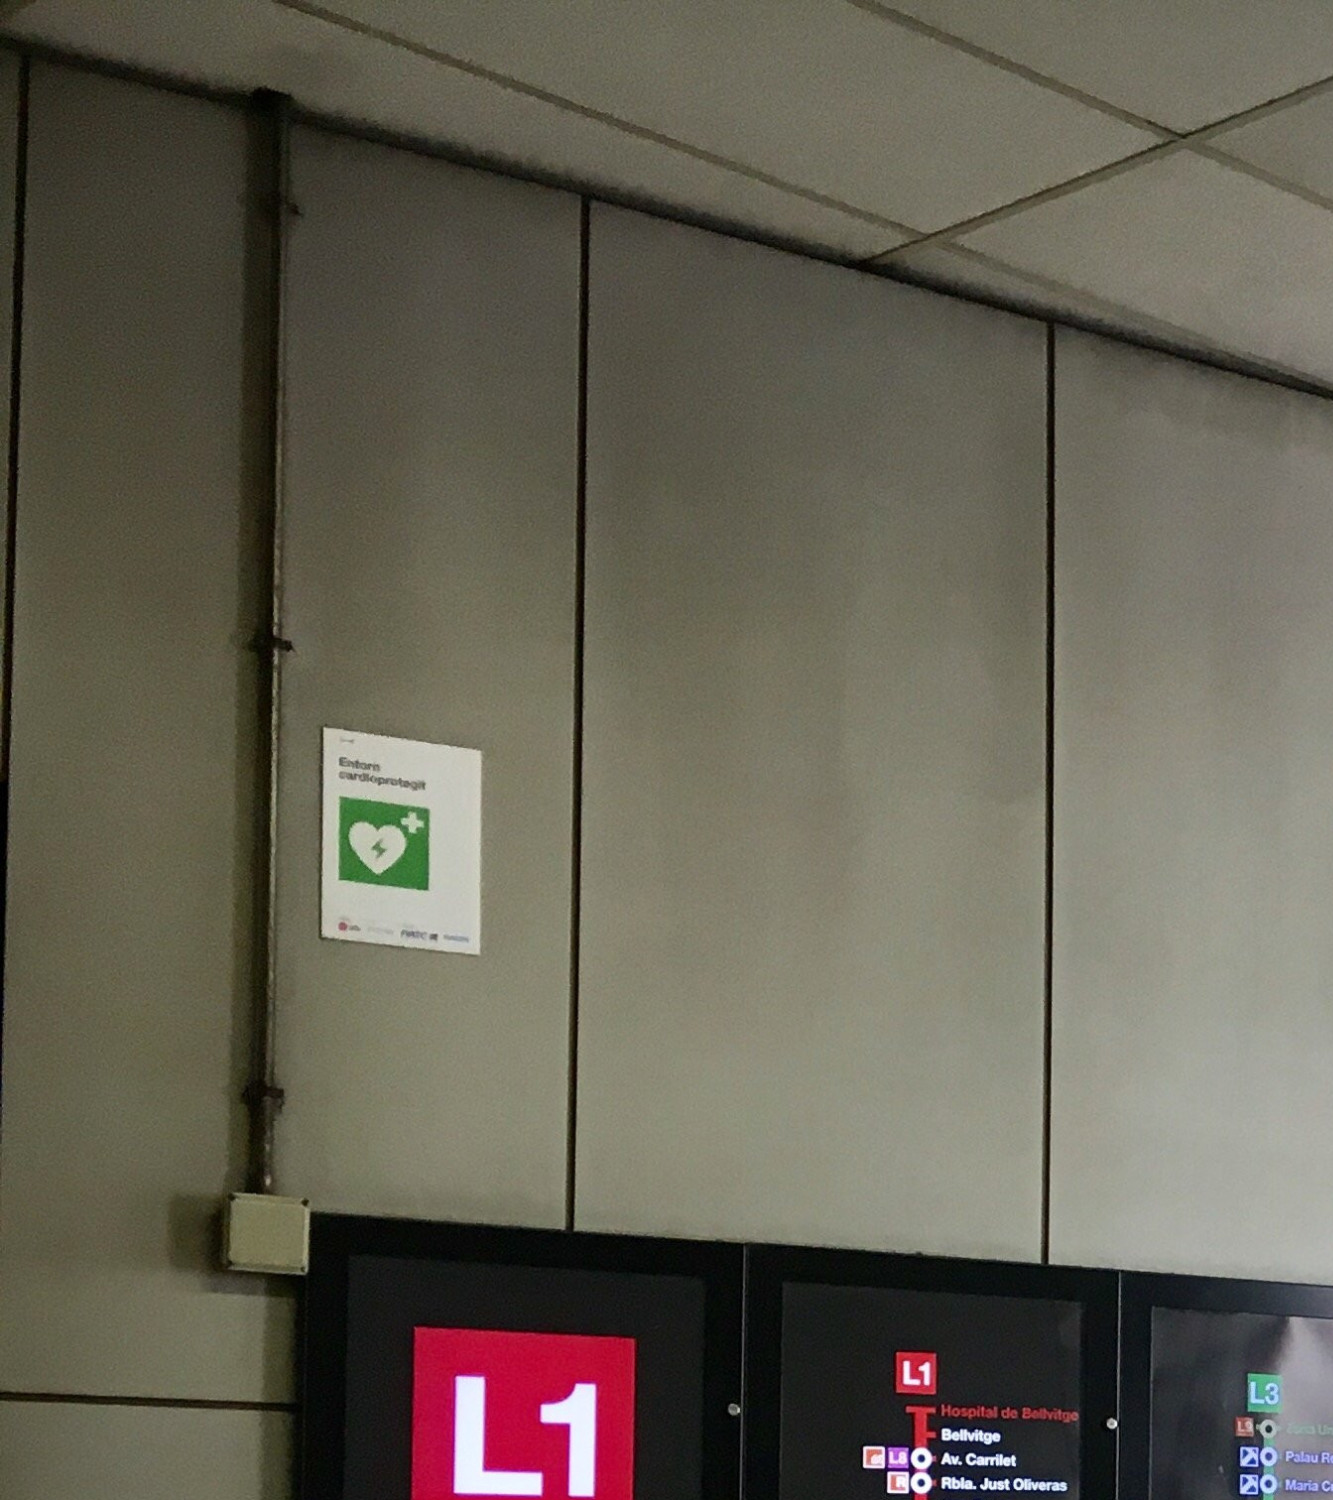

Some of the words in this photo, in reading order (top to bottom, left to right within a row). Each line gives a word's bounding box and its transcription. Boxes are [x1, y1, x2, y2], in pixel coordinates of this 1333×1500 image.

[902, 1361, 931, 1386] L1
[1250, 1383, 1279, 1404] L3
[941, 1404, 998, 1420] Hospital
[1001, 1407, 1018, 1419] de
[1022, 1408, 1079, 1422] Bellvitge
[451, 1376, 597, 1497] L1
[941, 1429, 1001, 1444] Bellvitge
[889, 1452, 908, 1464] L8
[941, 1454, 962, 1466] Av.
[966, 1454, 1016, 1467] Carrilet
[1285, 1452, 1318, 1464] Palau
[941, 1478, 976, 1490] Rbla.
[980, 1478, 1010, 1491] Just
[1014, 1479, 1067, 1491] Oliveras
